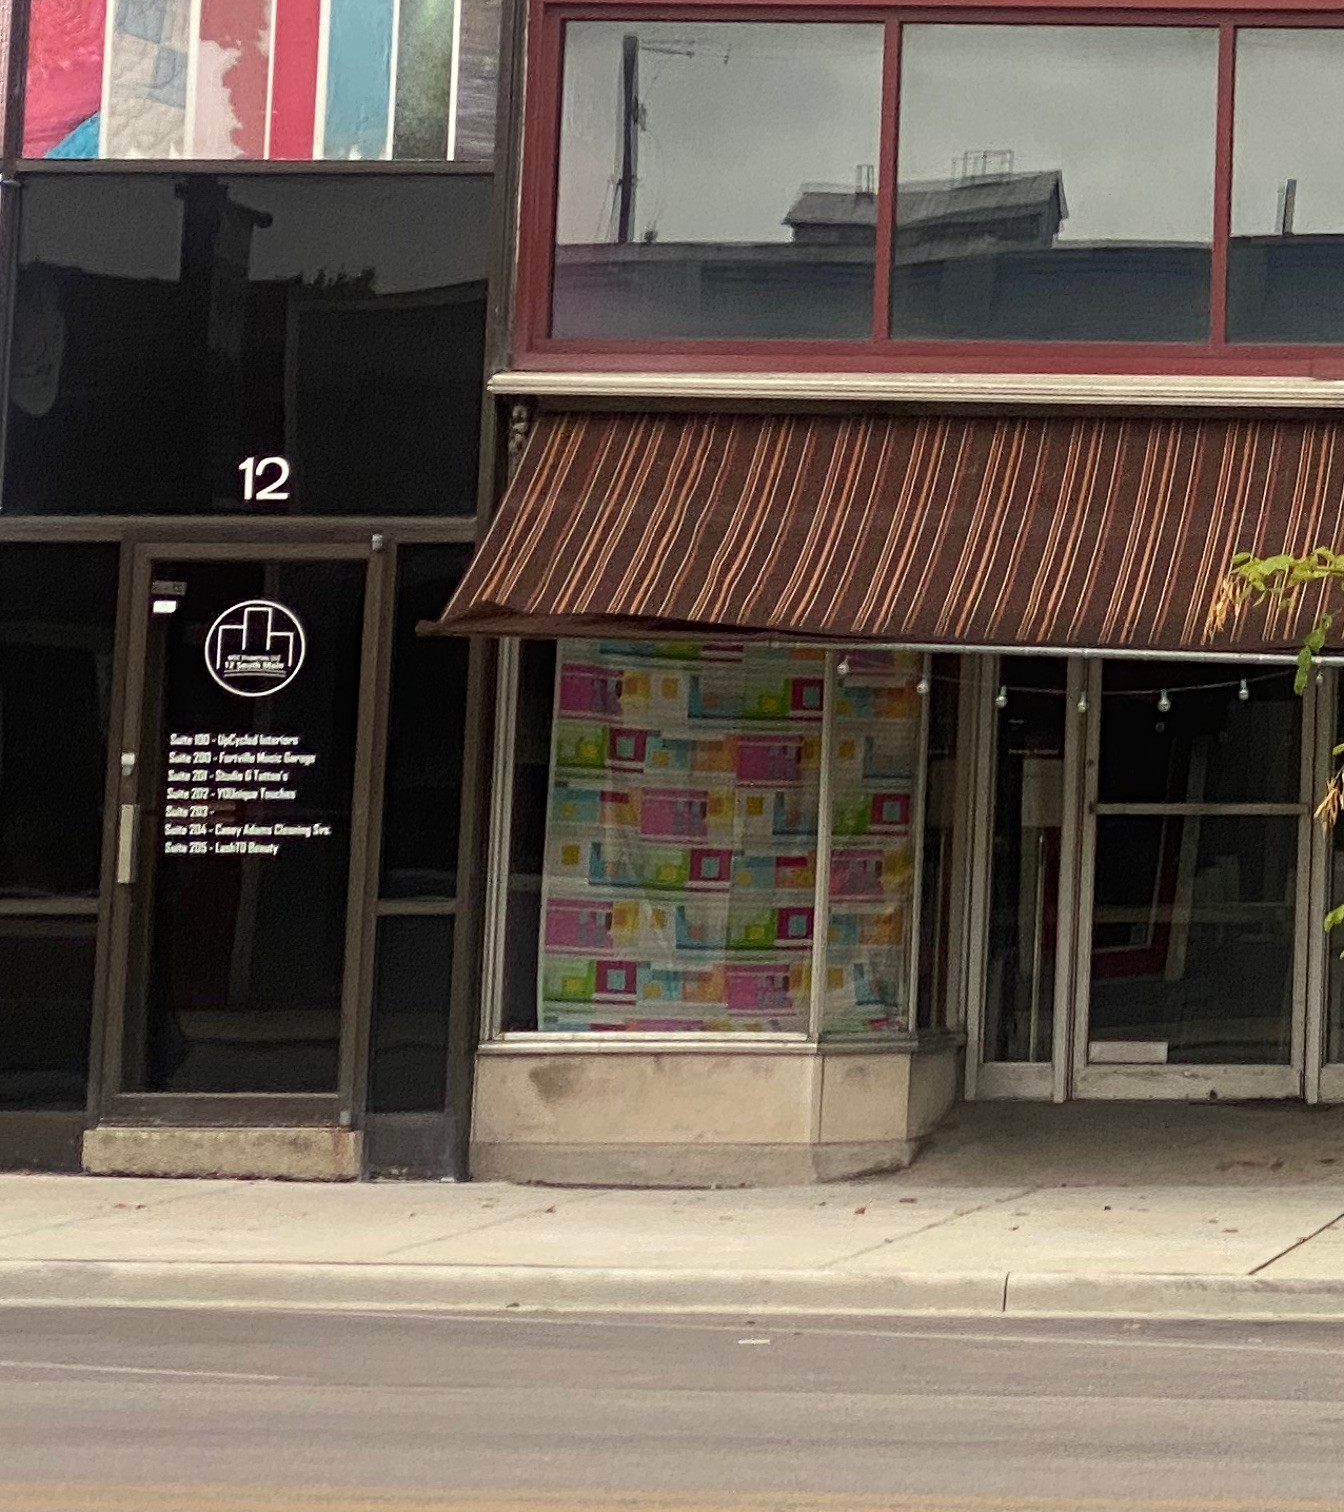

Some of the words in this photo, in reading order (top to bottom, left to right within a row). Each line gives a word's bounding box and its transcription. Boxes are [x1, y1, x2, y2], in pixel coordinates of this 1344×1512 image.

[238, 456, 290, 501] 12
[170, 733, 193, 745] Suite
[169, 751, 192, 764] Suite
[167, 769, 191, 782] Suite
[167, 787, 190, 800] Suite
[165, 805, 189, 818] Suite
[164, 823, 188, 836] Suite
[164, 841, 188, 854] Suite
